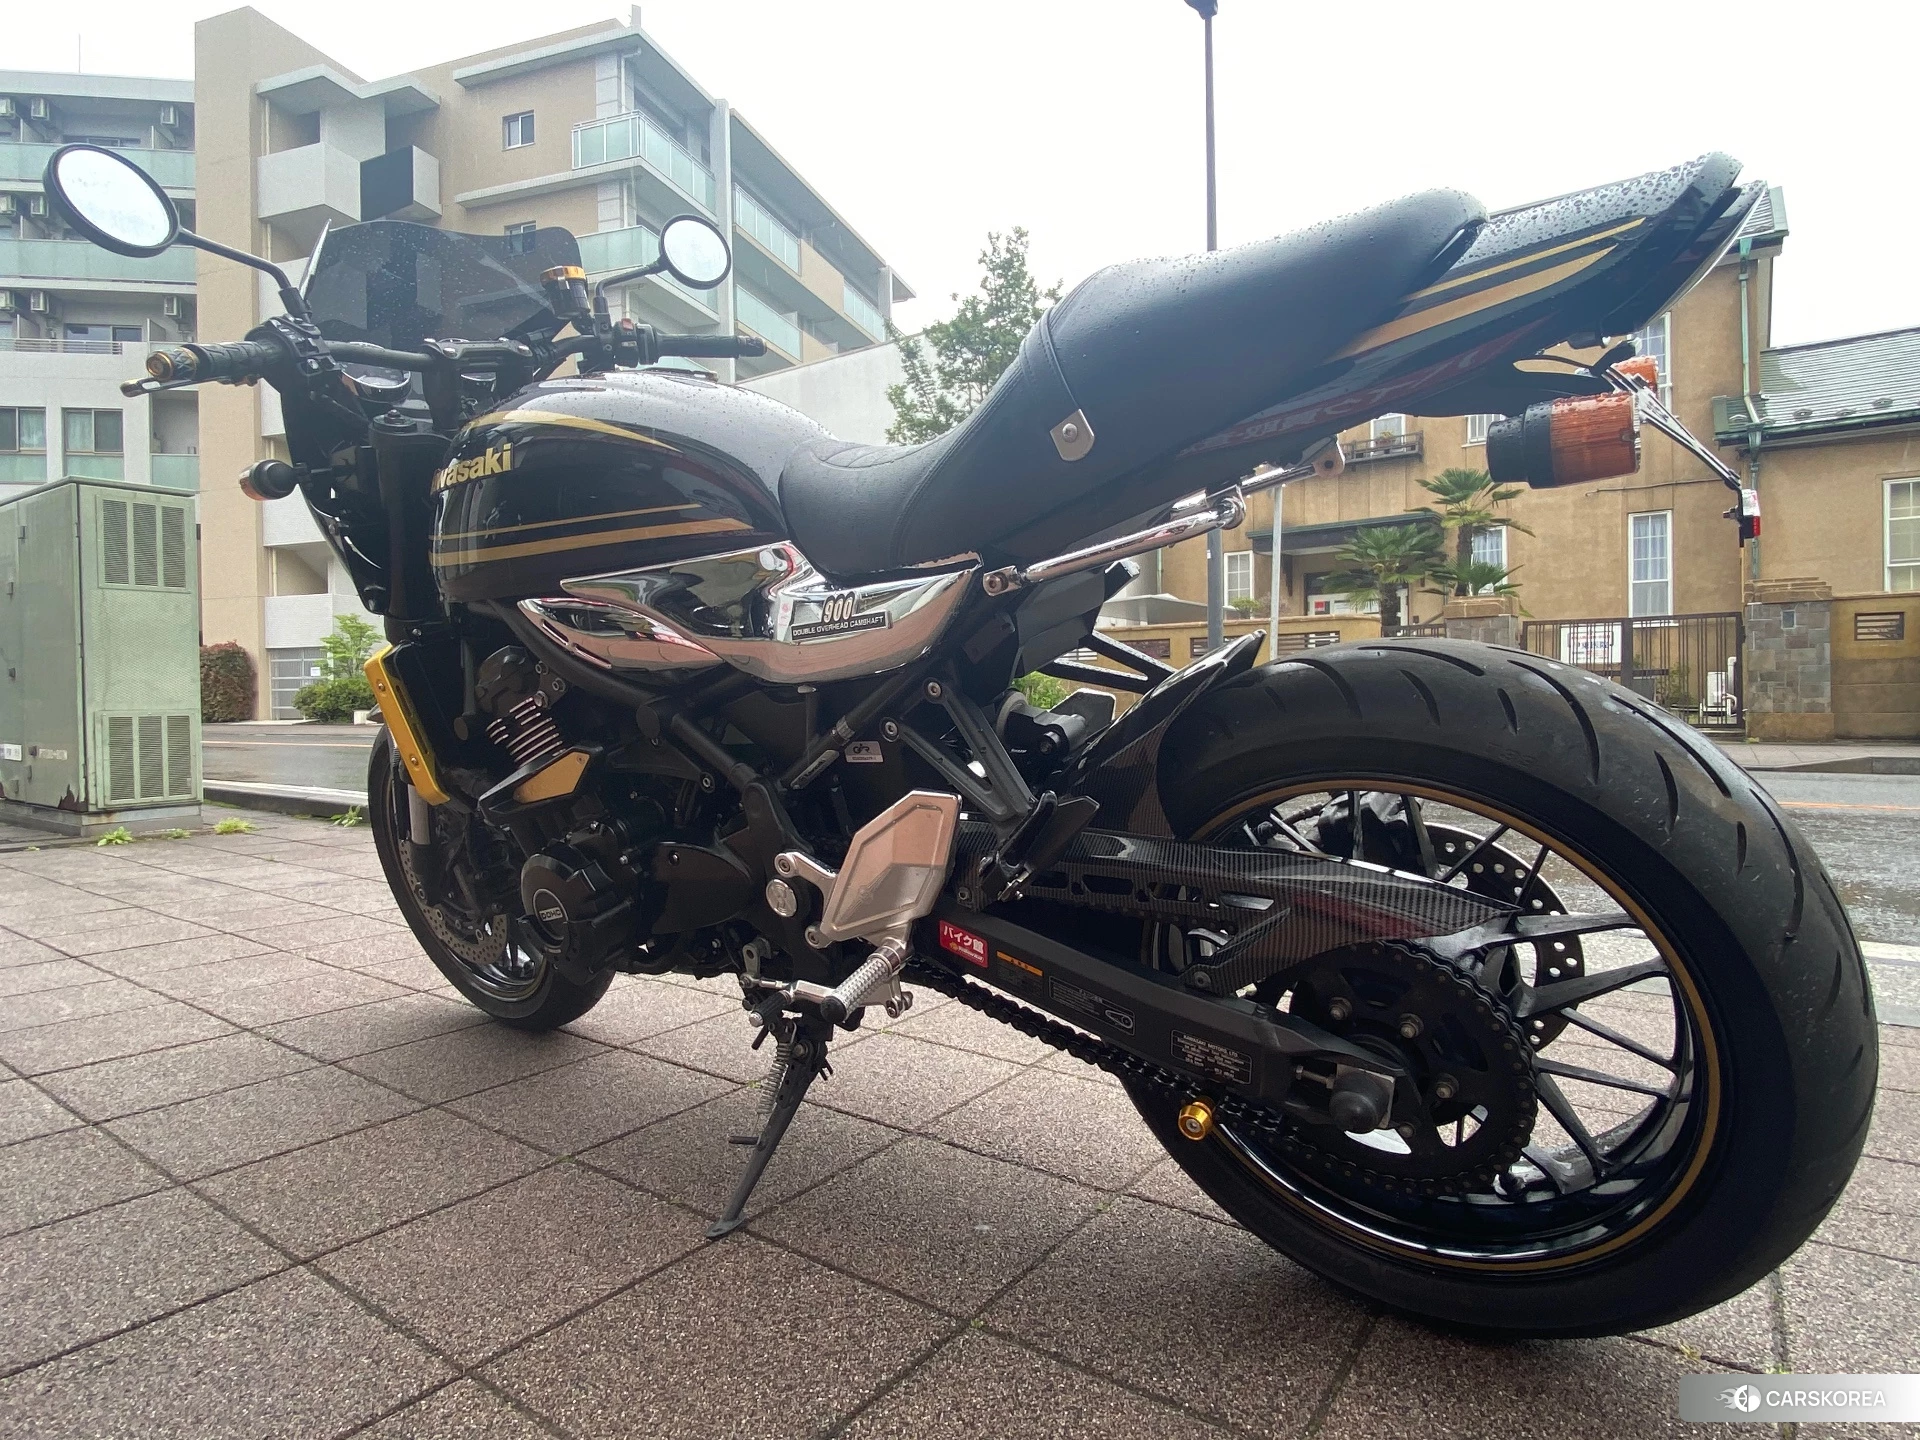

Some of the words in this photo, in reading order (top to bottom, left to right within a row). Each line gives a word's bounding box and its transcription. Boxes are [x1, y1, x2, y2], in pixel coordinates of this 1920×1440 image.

[431, 442, 512, 495] wasaki
[823, 597, 853, 622] 900
[793, 626, 815, 636] DOUBLE
[816, 621, 849, 633] OVERHEAD
[850, 616, 884, 628] CAMSHAFT
[541, 909, 561, 919] DOHC
